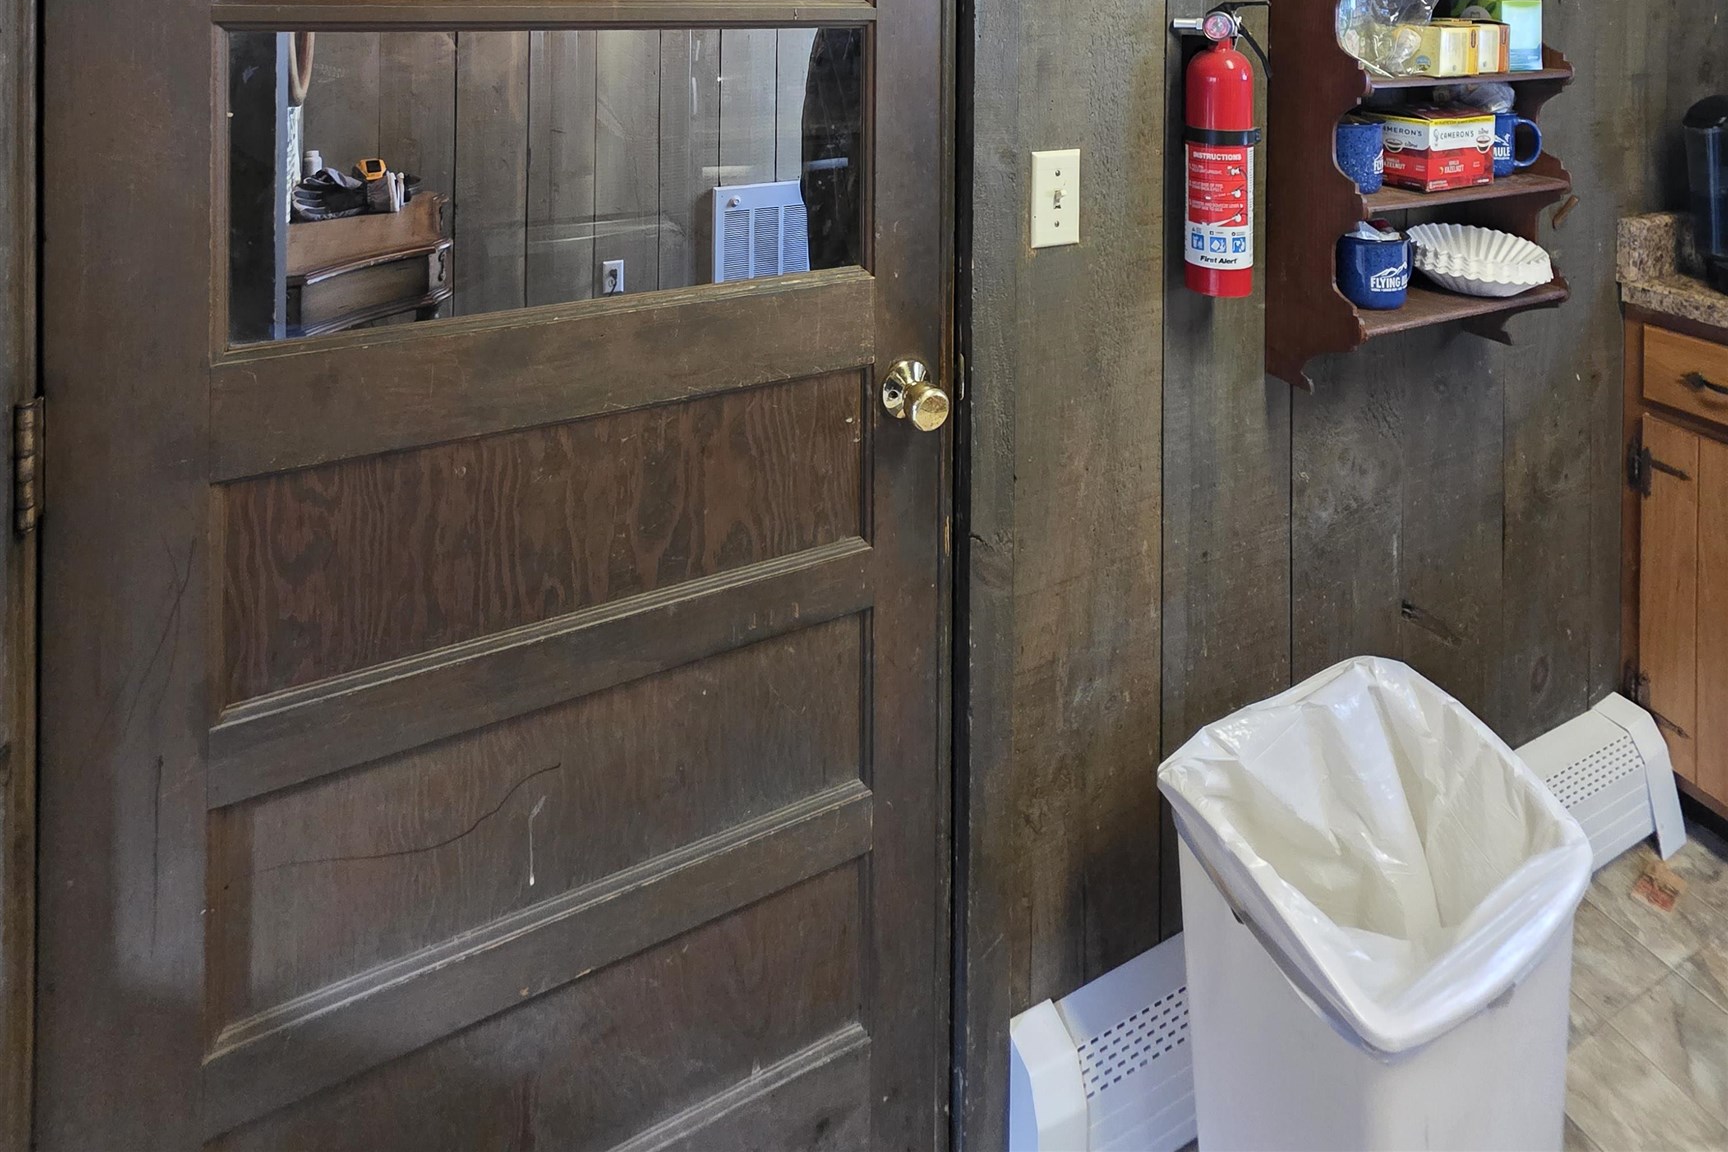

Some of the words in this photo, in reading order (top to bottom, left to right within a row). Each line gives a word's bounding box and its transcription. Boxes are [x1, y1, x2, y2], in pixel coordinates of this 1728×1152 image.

[1382, 125, 1422, 137] AMERON'S
[1440, 130, 1475, 140] CAMERON'S
[1193, 151, 1242, 161] INSTRUCTIONS
[1200, 255, 1217, 264] First
[1370, 276, 1401, 288] FLYING
